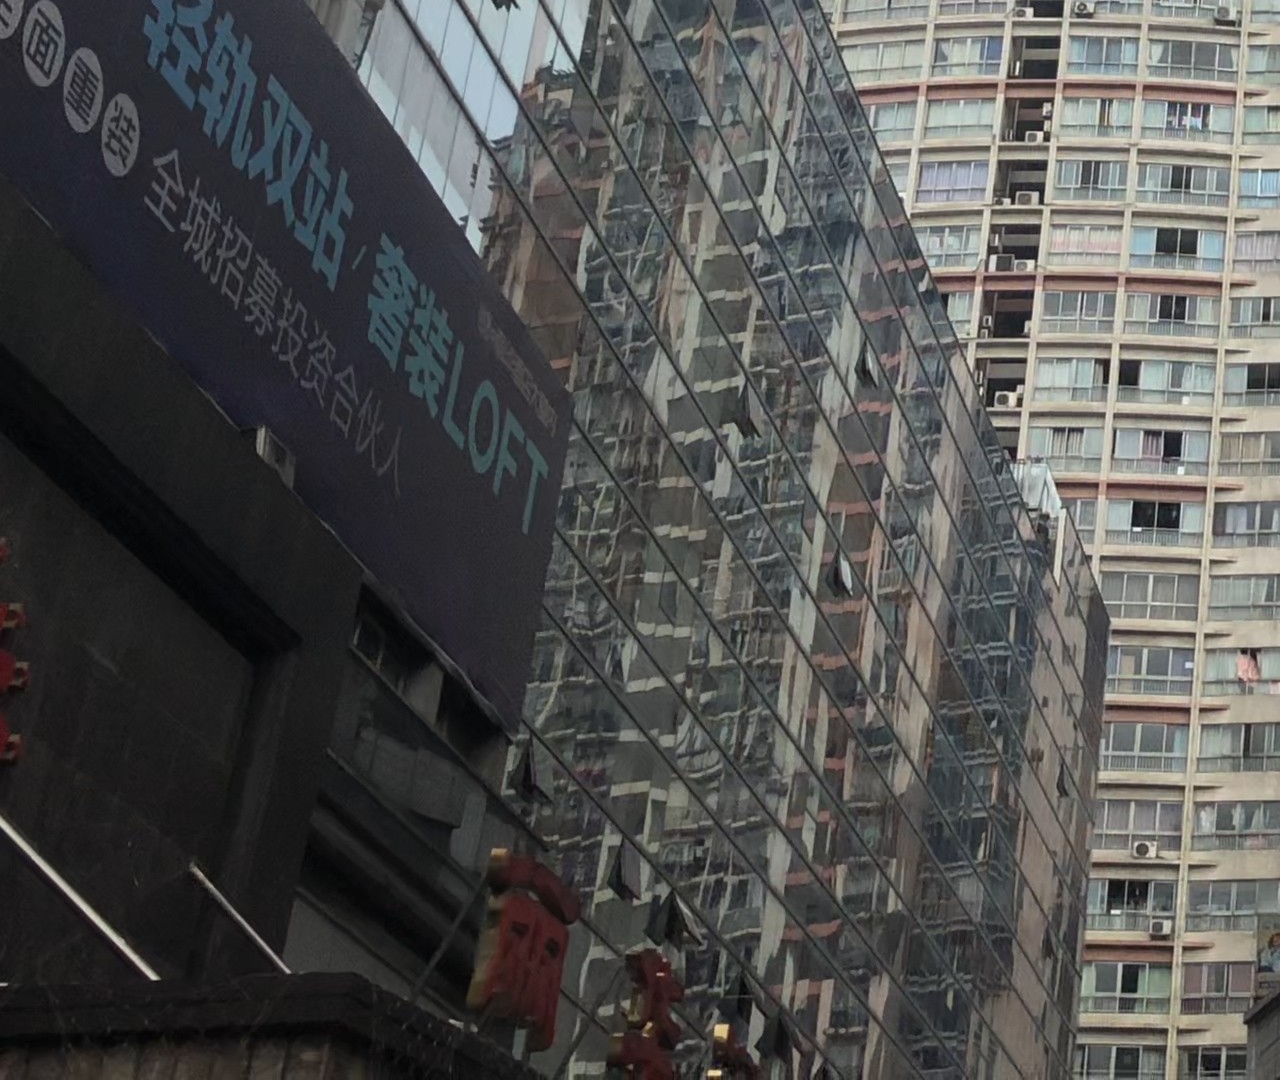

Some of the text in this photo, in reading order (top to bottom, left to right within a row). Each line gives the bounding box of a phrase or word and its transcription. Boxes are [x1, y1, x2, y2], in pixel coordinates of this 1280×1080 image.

[144, 149, 401, 495] 全城招募投资合伙人
